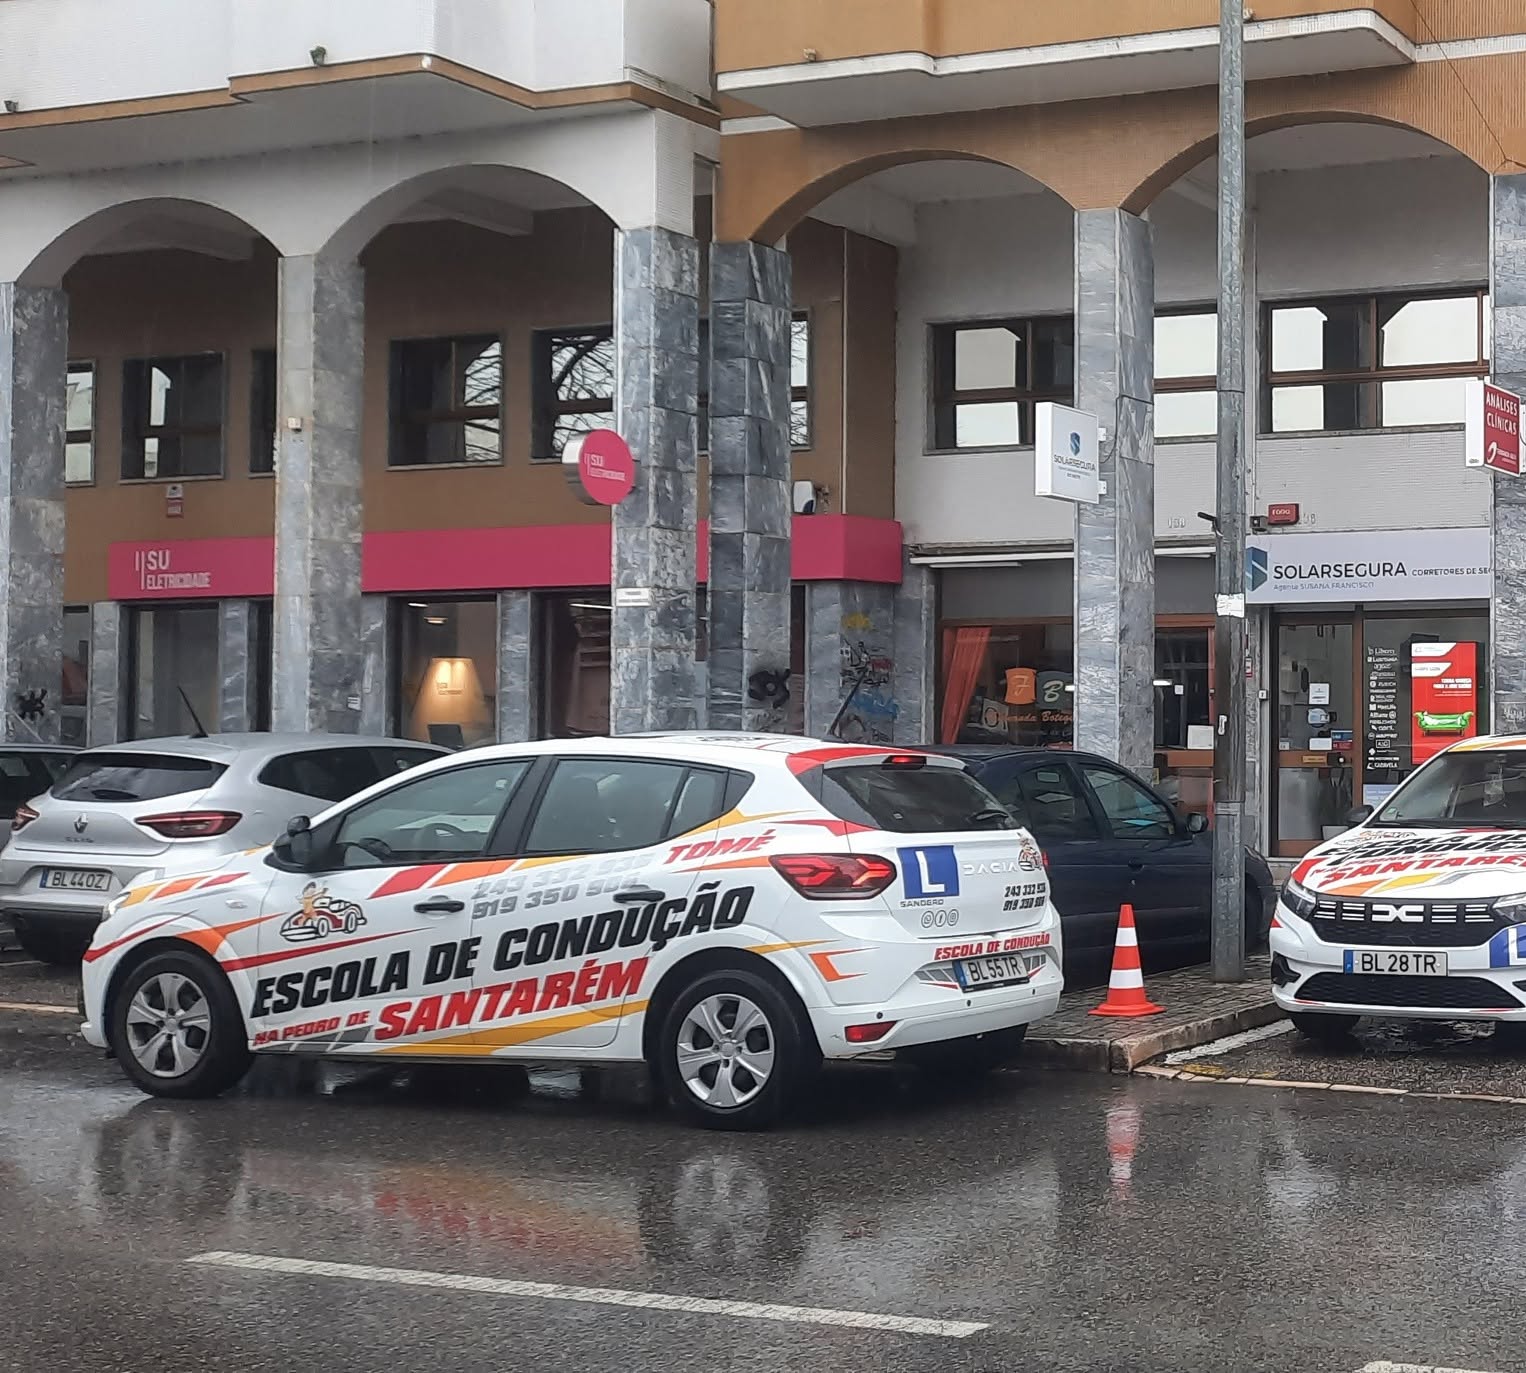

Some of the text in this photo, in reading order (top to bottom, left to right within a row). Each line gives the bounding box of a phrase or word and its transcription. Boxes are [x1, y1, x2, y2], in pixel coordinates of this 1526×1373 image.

[1486, 391, 1518, 417] ANÁLISES
[1486, 412, 1517, 436] CLÍNICAS
[146, 549, 170, 571] SU
[1273, 562, 1408, 580] SOLARSEGURA
[1411, 567, 1465, 577] CORRETORES
[1466, 567, 1477, 576] DE
[663, 828, 777, 865] TOMÉ
[914, 850, 945, 894] L
[471, 896, 519, 920] 919
[524, 883, 581, 909] 350
[900, 898, 945, 908] SANDERO
[249, 880, 755, 1019] ESCOLA DE CONDUÇÃO
[934, 941, 984, 960] ESCOLA
[986, 940, 1003, 953] DE
[282, 1016, 342, 1042] PEDRO
[345, 1010, 371, 1027] DE
[374, 956, 650, 1041] SANTARÉM
